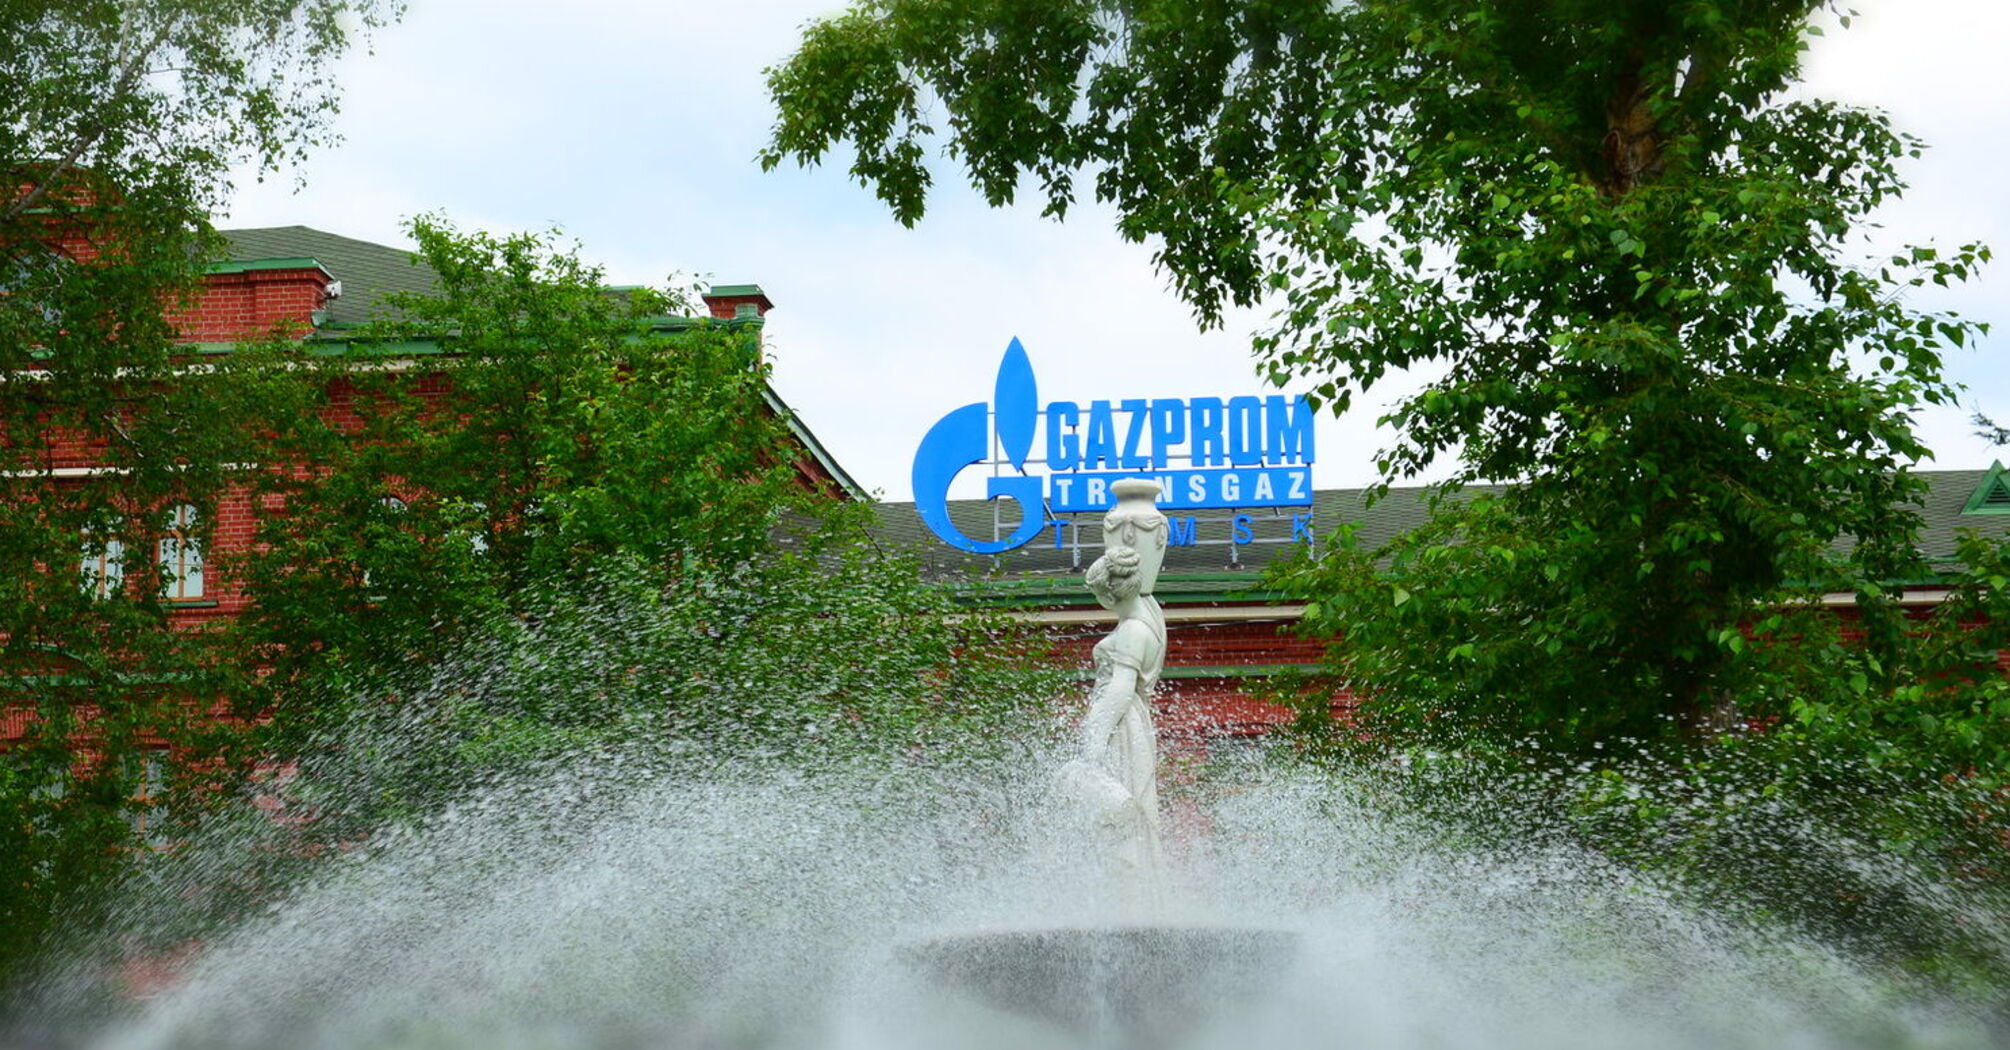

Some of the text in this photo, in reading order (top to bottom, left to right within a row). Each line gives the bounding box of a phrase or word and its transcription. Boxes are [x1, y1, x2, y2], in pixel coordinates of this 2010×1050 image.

[1046, 394, 1315, 472] GAZPROM
[1056, 472, 1306, 507] TRNSGAZ
[1050, 512, 1313, 550] TMSK
